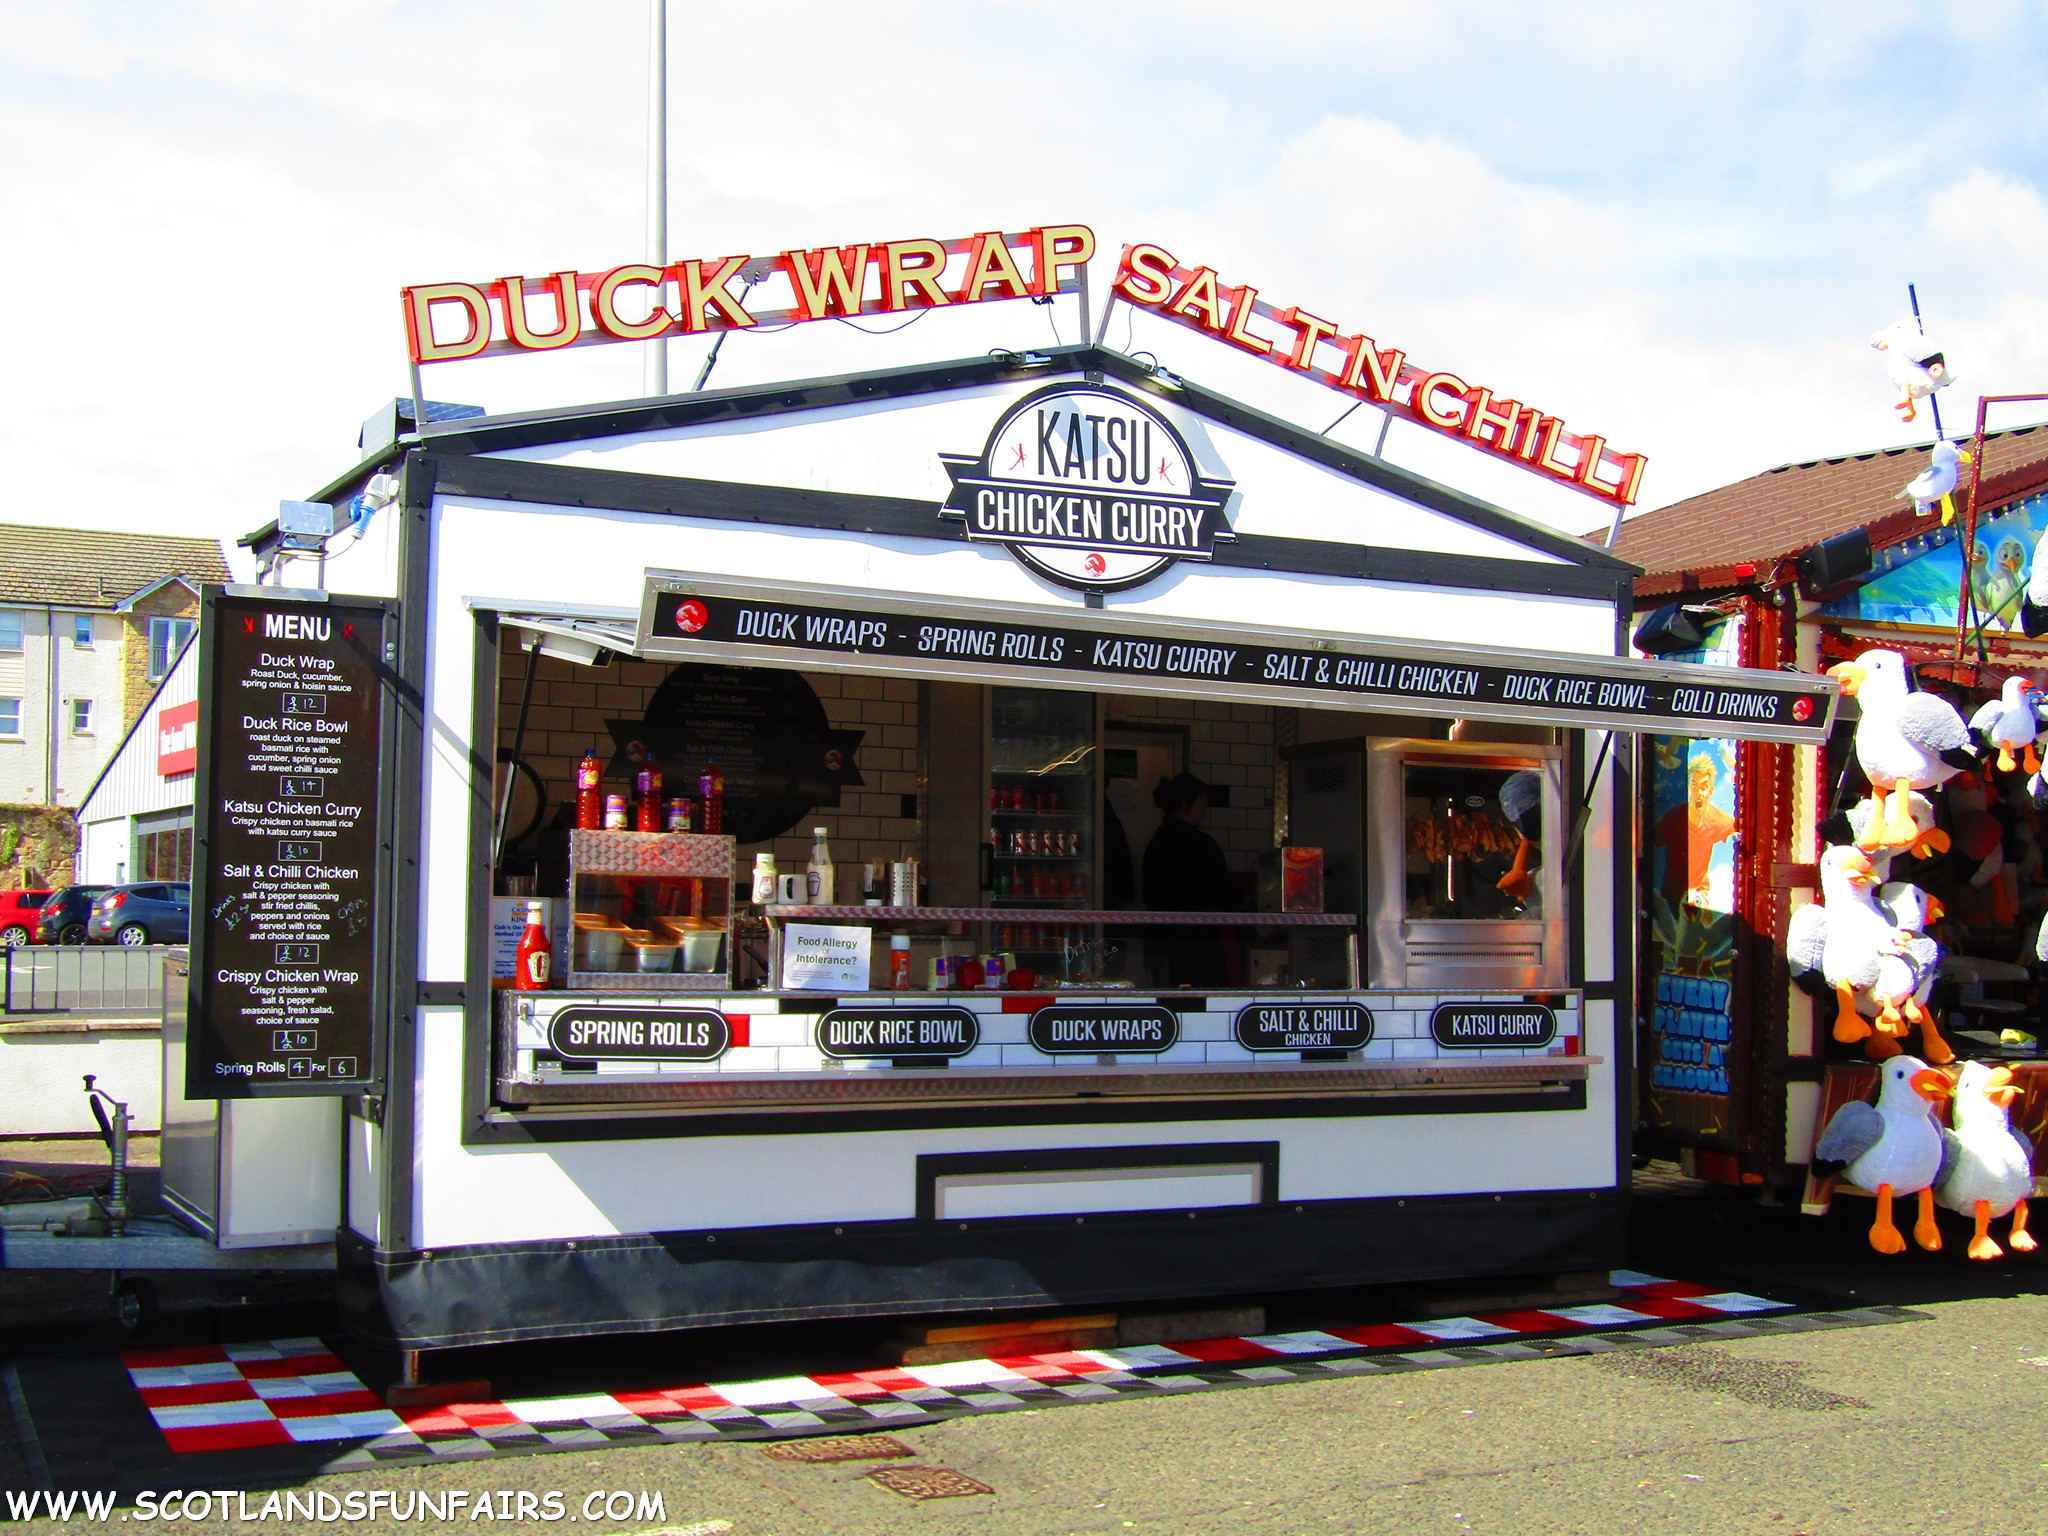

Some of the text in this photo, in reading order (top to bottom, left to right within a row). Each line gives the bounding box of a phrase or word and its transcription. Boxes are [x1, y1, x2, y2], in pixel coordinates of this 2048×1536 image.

[402, 224, 1095, 365] DUCK WRAP
[1112, 243, 1648, 506] SALT N CHILLI
[1038, 409, 1150, 485] KATSU
[977, 489, 1204, 548] CHICKEN CURRY
[265, 614, 331, 641] MENU
[261, 653, 335, 670] Duck Wrap
[736, 610, 1778, 719] DUCK WRAPS SPRING ROLLS KATSU CURRY SALT & CHILLI CHICKEN DUCK RICE BOWL COLD DRINKS
[250, 669, 344, 682] Roast Duck, cucumber,
[241, 679, 267, 690] spring
[269, 681, 292, 689] onion
[294, 681, 300, 689] &
[302, 682, 326, 690] hoisin
[243, 716, 348, 733] Duck Rice Bowl
[273, 734, 292, 743] duck
[306, 736, 341, 744] steamed
[261, 744, 293, 752] basmati
[248, 754, 341, 765] cucumber, spring onion
[268, 765, 292, 773] sweet
[225, 800, 362, 818] Katsu Chicken Curry
[232, 817, 258, 826] Crispy
[260, 818, 293, 826] chicken
[306, 819, 337, 827] basmati
[266, 828, 288, 836] katsu
[291, 829, 311, 838] curry
[224, 865, 359, 879] Salt & Chilli Chicken
[253, 881, 330, 890] Crispy chicken with
[259, 892, 265, 900] &
[267, 893, 297, 901] pepper
[298, 892, 339, 902] seasoning
[276, 902, 294, 910] fried
[296, 902, 320, 911] chillis,
[250, 912, 330, 921] peppers and onions
[259, 922, 321, 930] served with rice
[250, 932, 265, 940] and
[267, 932, 293, 940] choice
[295, 932, 304, 940] of
[798, 936, 857, 949] Food Allergy
[796, 954, 857, 965] Intolerance?
[218, 970, 359, 984] Crispy Chicken Wrap
[250, 986, 327, 995] Crispy chicken with
[1657, 974, 1729, 1013] EVERY
[262, 996, 315, 1006] salt & pepper
[241, 1006, 334, 1016] seasoning, fresh salad,
[1259, 1009, 1358, 1032] SALT & CHILLI
[1452, 1014, 1543, 1036] KATSU CURRY
[1652, 1005, 1731, 1043] PLAYER
[570, 1020, 709, 1047] SPRING ROLLS
[829, 1019, 966, 1045] DUCK RICE BOWL
[1052, 1019, 1162, 1042] DUCK WRAPS
[1285, 1033, 1331, 1046] CHICKEN
[1661, 1037, 1725, 1068] GETS A
[215, 1063, 253, 1075] Spring
[257, 1062, 285, 1073] Rolls
[293, 1061, 304, 1073] 4
[338, 1061, 346, 1073] 6
[1652, 1063, 1731, 1094] SEAGULL
